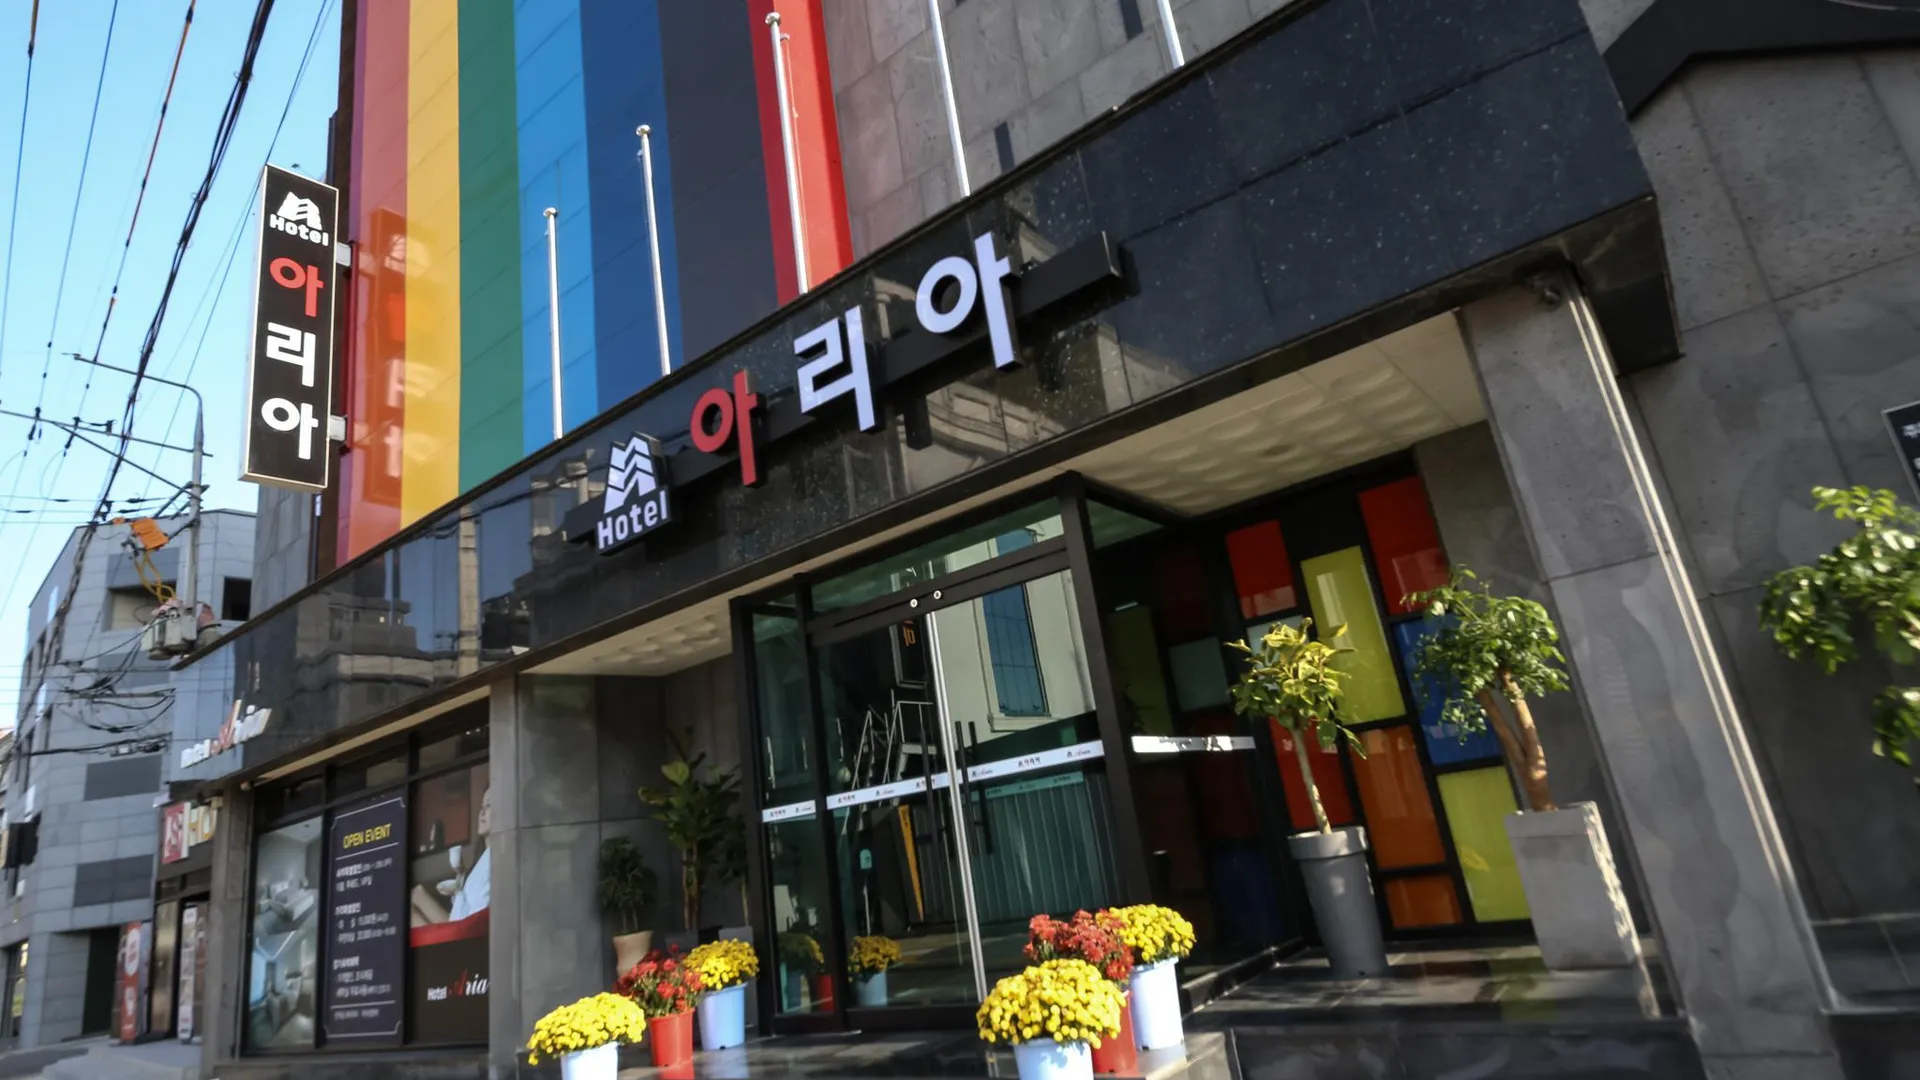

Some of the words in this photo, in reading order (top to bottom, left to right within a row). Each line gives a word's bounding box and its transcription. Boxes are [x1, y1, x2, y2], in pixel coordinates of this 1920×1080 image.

[269, 212, 329, 247] Hotel
[261, 256, 325, 461] 아리아
[690, 231, 1017, 486] 아리아
[596, 489, 668, 552] Hotel
[342, 831, 365, 849] OPEN
[364, 823, 392, 844] EVENT
[426, 985, 448, 1001] Hotel
